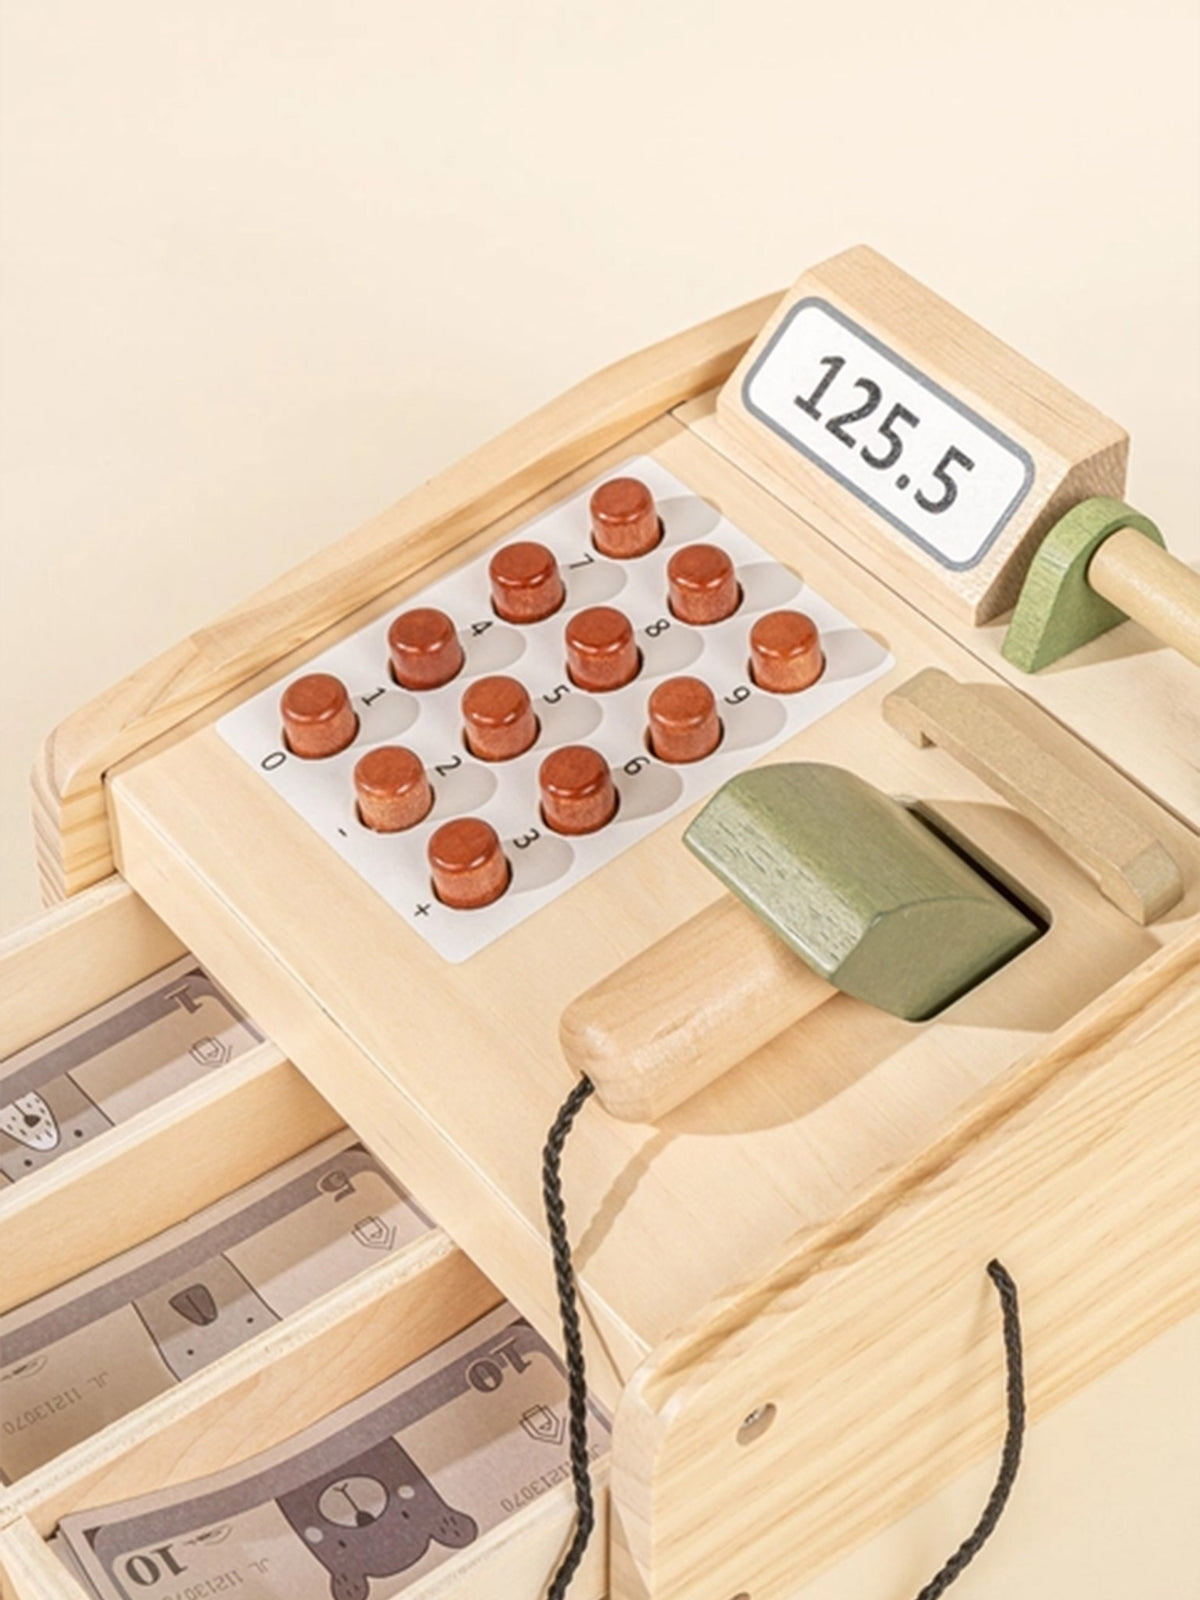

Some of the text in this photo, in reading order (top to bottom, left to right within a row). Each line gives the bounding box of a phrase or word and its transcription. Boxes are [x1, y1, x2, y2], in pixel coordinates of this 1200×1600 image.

[793, 355, 975, 514] 125.5
[569, 553, 595, 570] 7
[471, 620, 494, 637] 4
[645, 618, 670, 638] 8
[361, 687, 386, 706] 1
[543, 684, 570, 704] 5
[724, 686, 751, 705] 9
[261, 751, 286, 771] 0
[435, 755, 462, 776] 2
[623, 756, 650, 776] 6
[513, 828, 540, 849] 3
[168, 985, 203, 1014] 1
[320, 1171, 356, 1202] 5
[468, 1338, 532, 1393] 10
[125, 1543, 188, 1586] 10
